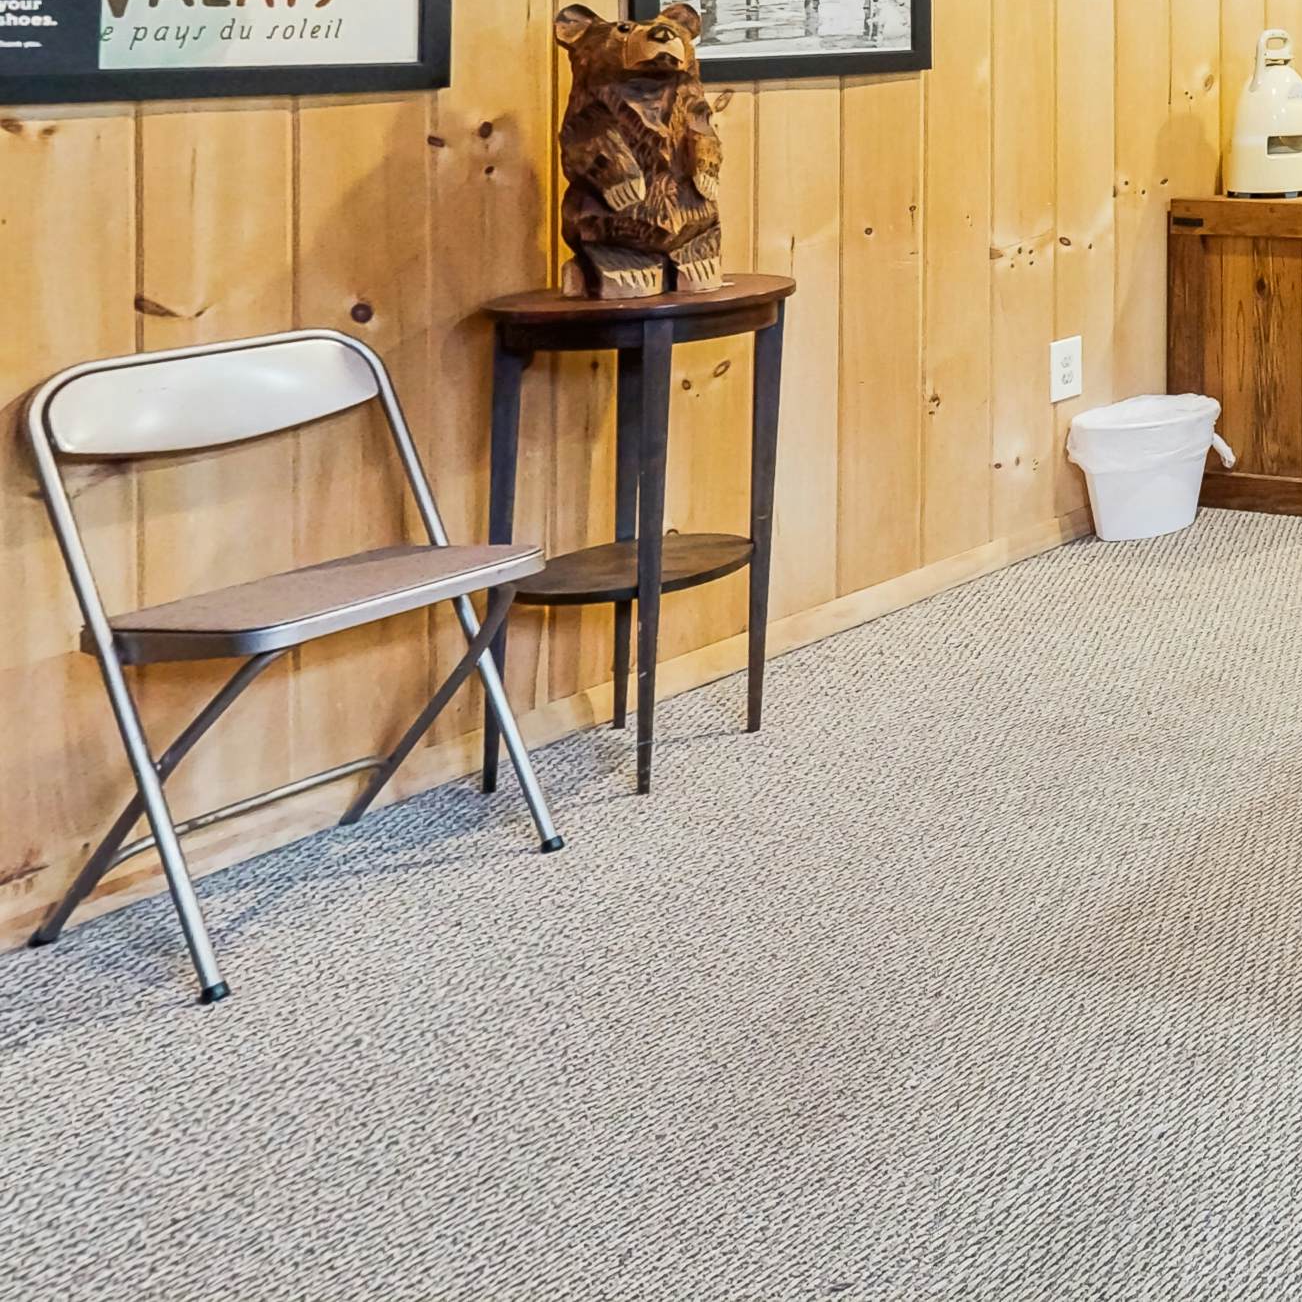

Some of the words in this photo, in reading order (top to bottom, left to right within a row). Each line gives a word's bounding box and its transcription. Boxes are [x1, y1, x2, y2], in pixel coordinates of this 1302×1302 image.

[0, 0, 43, 13] your
[129, 23, 207, 51] pays
[219, 17, 253, 41] du
[265, 17, 344, 41] soleil
